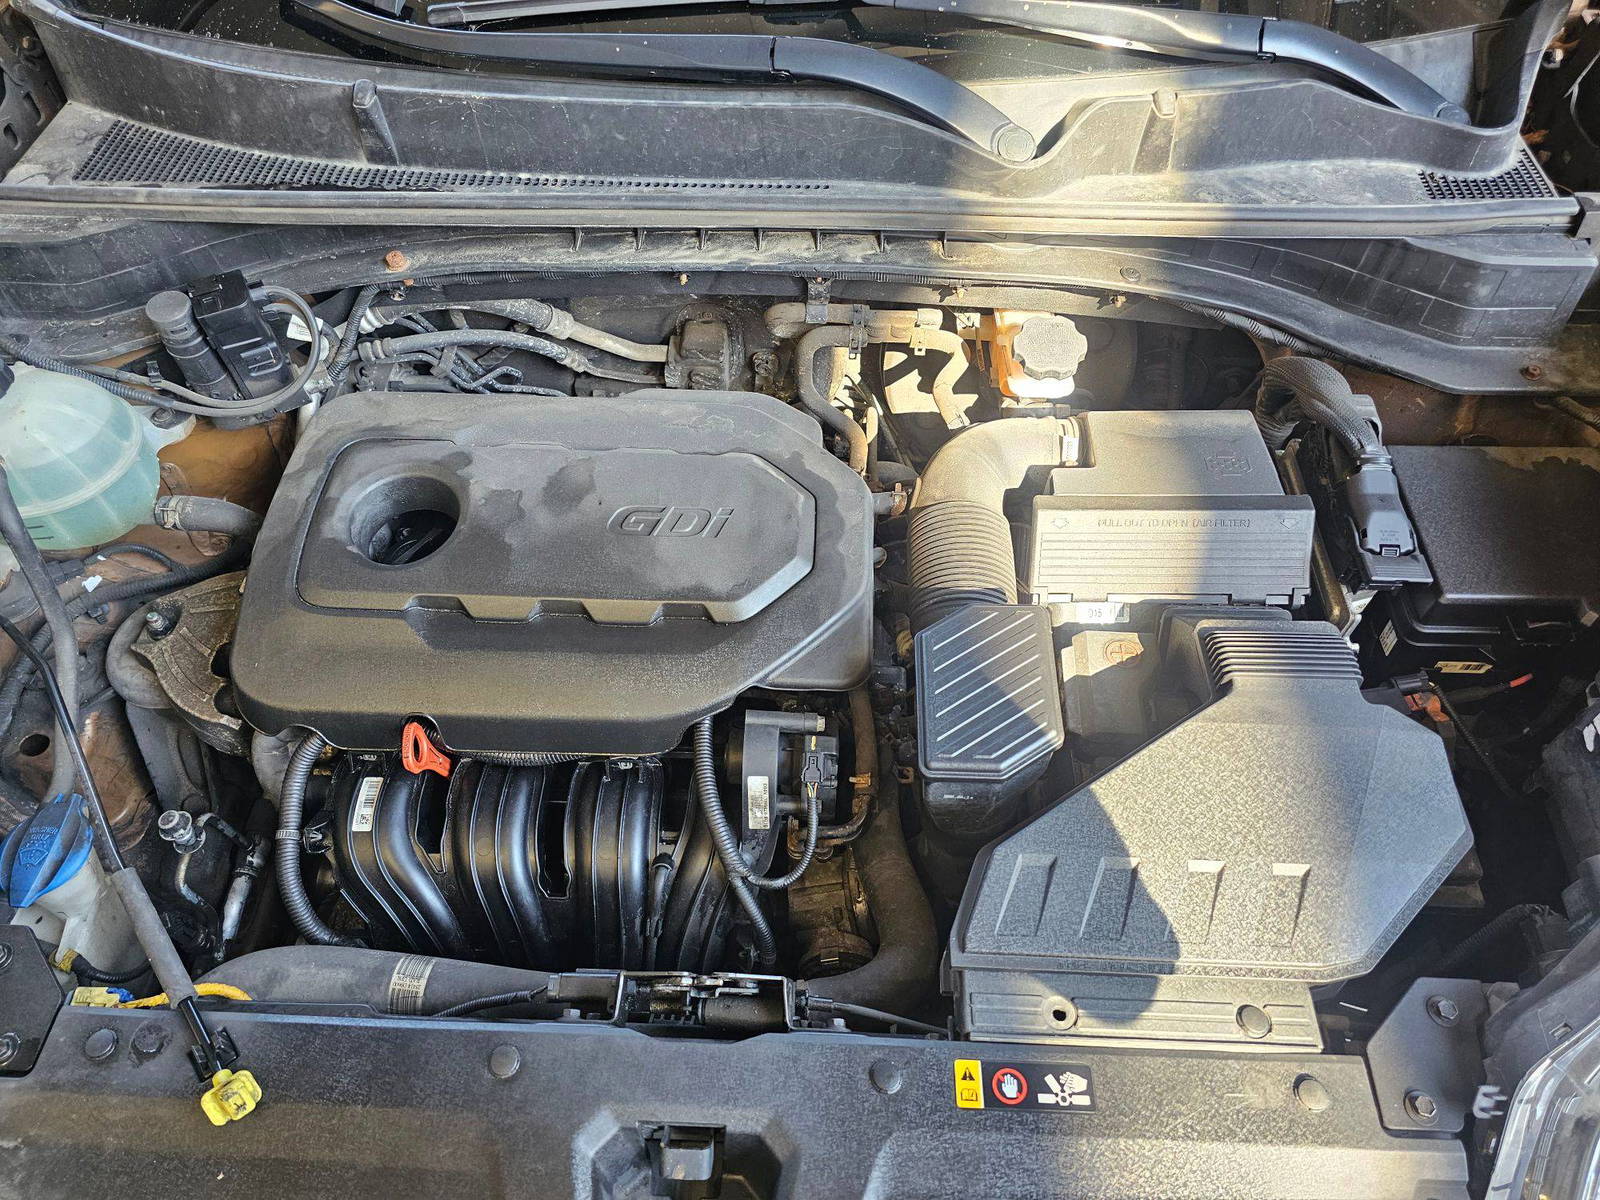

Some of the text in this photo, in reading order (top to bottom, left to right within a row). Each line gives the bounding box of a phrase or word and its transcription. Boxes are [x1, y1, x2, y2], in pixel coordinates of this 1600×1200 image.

[605, 505, 735, 538] GDi
[1097, 518, 1123, 528] PULL
[1124, 518, 1145, 528] OUT
